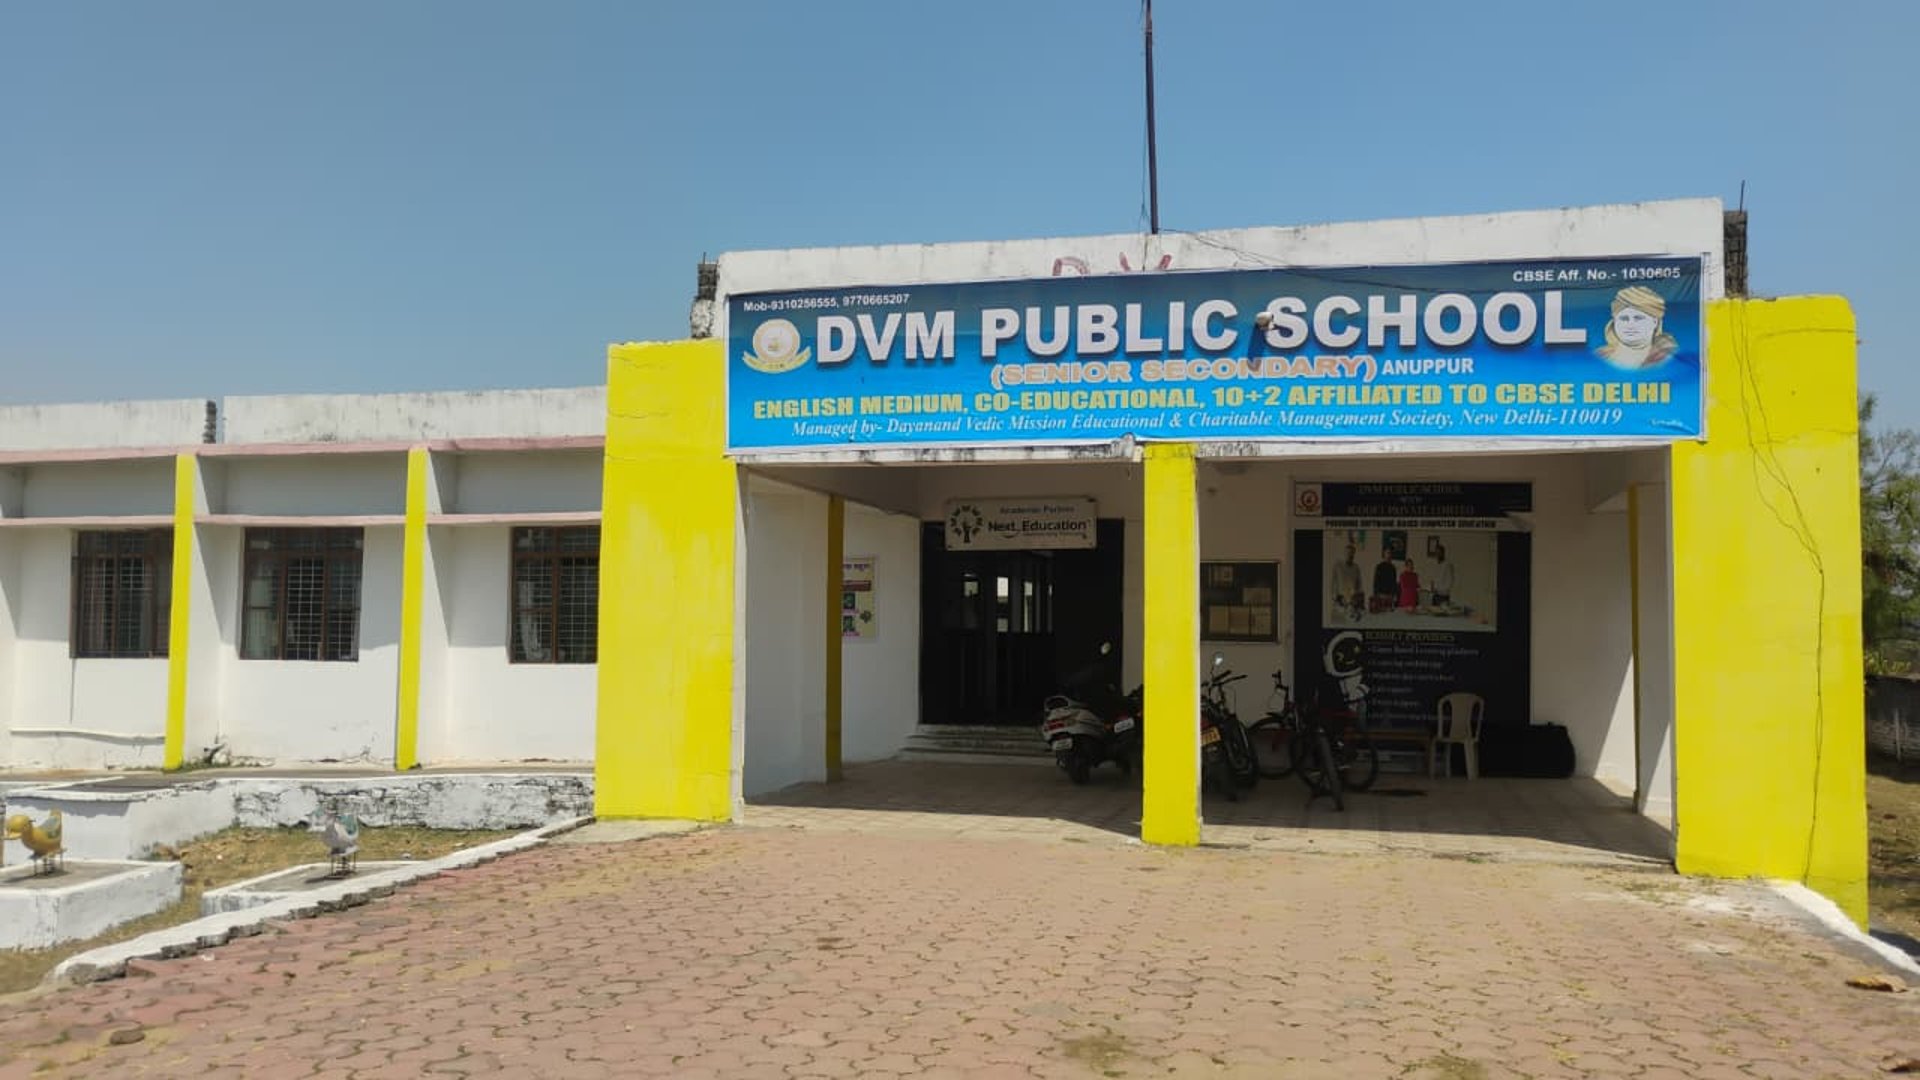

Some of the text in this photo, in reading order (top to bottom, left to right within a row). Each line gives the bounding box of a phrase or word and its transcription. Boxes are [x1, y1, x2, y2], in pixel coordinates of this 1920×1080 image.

[1513, 270, 1554, 282] CBSE
[1557, 269, 1581, 281] Aff.
[816, 291, 1587, 363] DVM PUBLIC SCHOOL
[991, 355, 1378, 390] (SENIOR SECONDARY)
[1382, 358, 1474, 375] ANUPPUR
[753, 382, 1671, 419] ENGLISH MEDIUM, CO-EDUCATIONAL, 10+2 AFFILIATED TO CBSE DELHI
[792, 407, 1623, 438] Managed by- Dayanand Vedic Mission Educational & Charitable Management Society, New Delhi-110019
[988, 518, 1087, 532] Next Education
